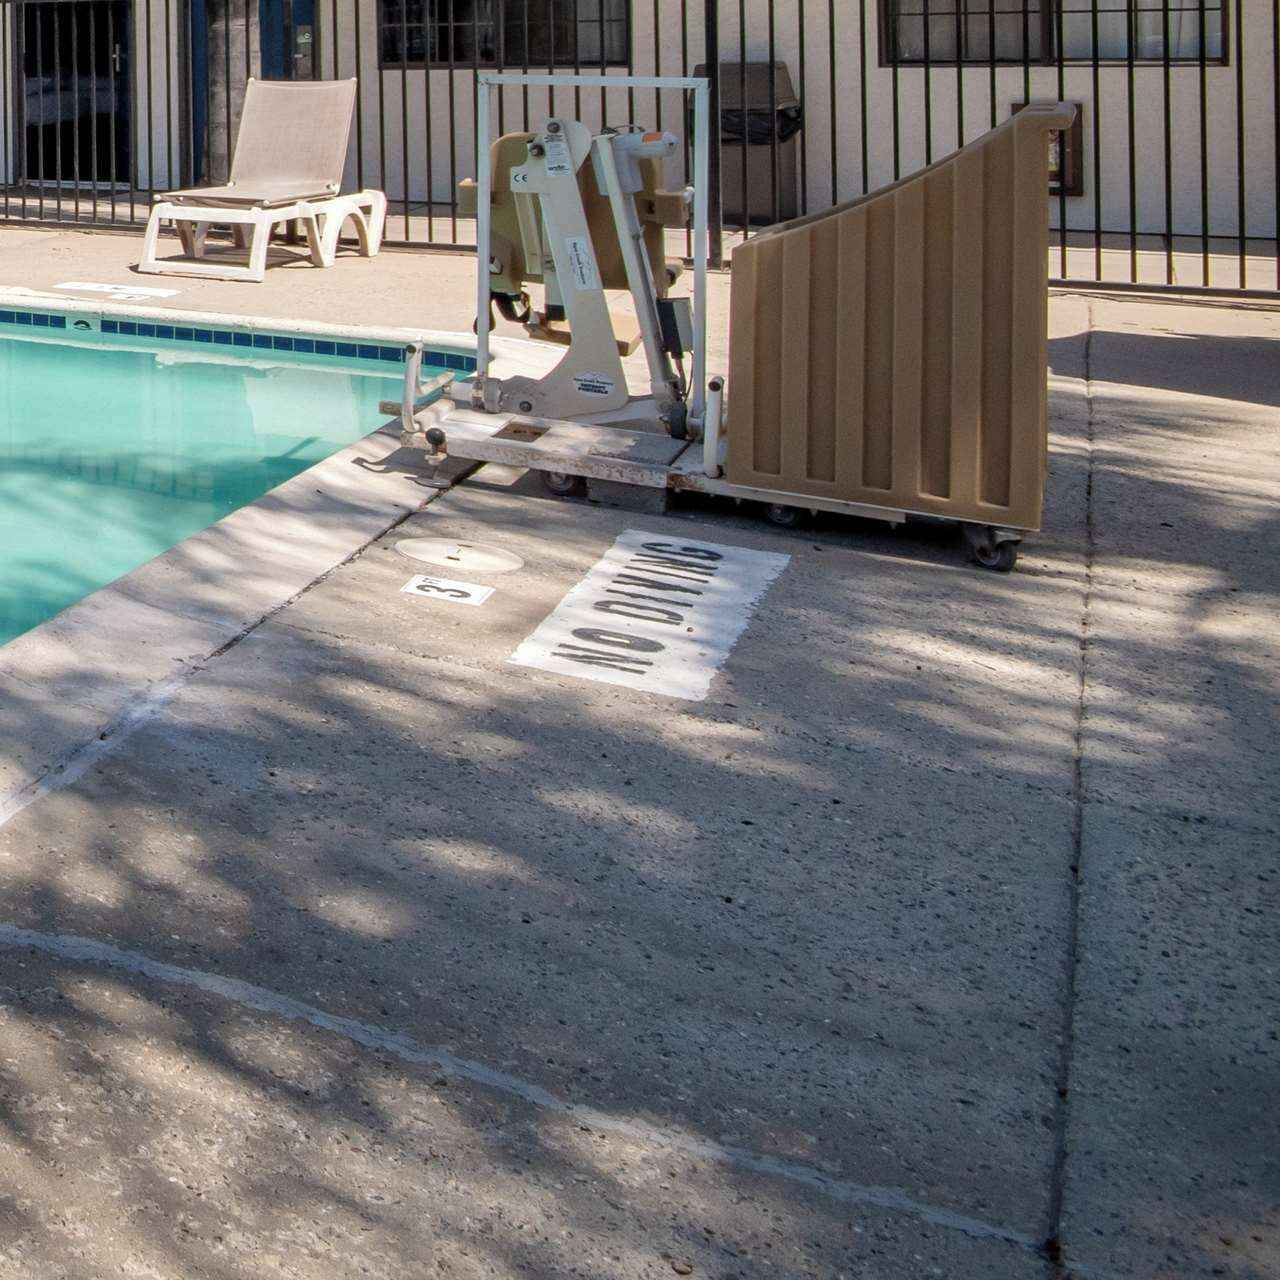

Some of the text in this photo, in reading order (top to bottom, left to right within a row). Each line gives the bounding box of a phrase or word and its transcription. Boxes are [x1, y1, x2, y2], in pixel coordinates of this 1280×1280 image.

[513, 174, 527, 183] CE
[416, 584, 472, 599] 3
[551, 542, 723, 675] NO DIVING
